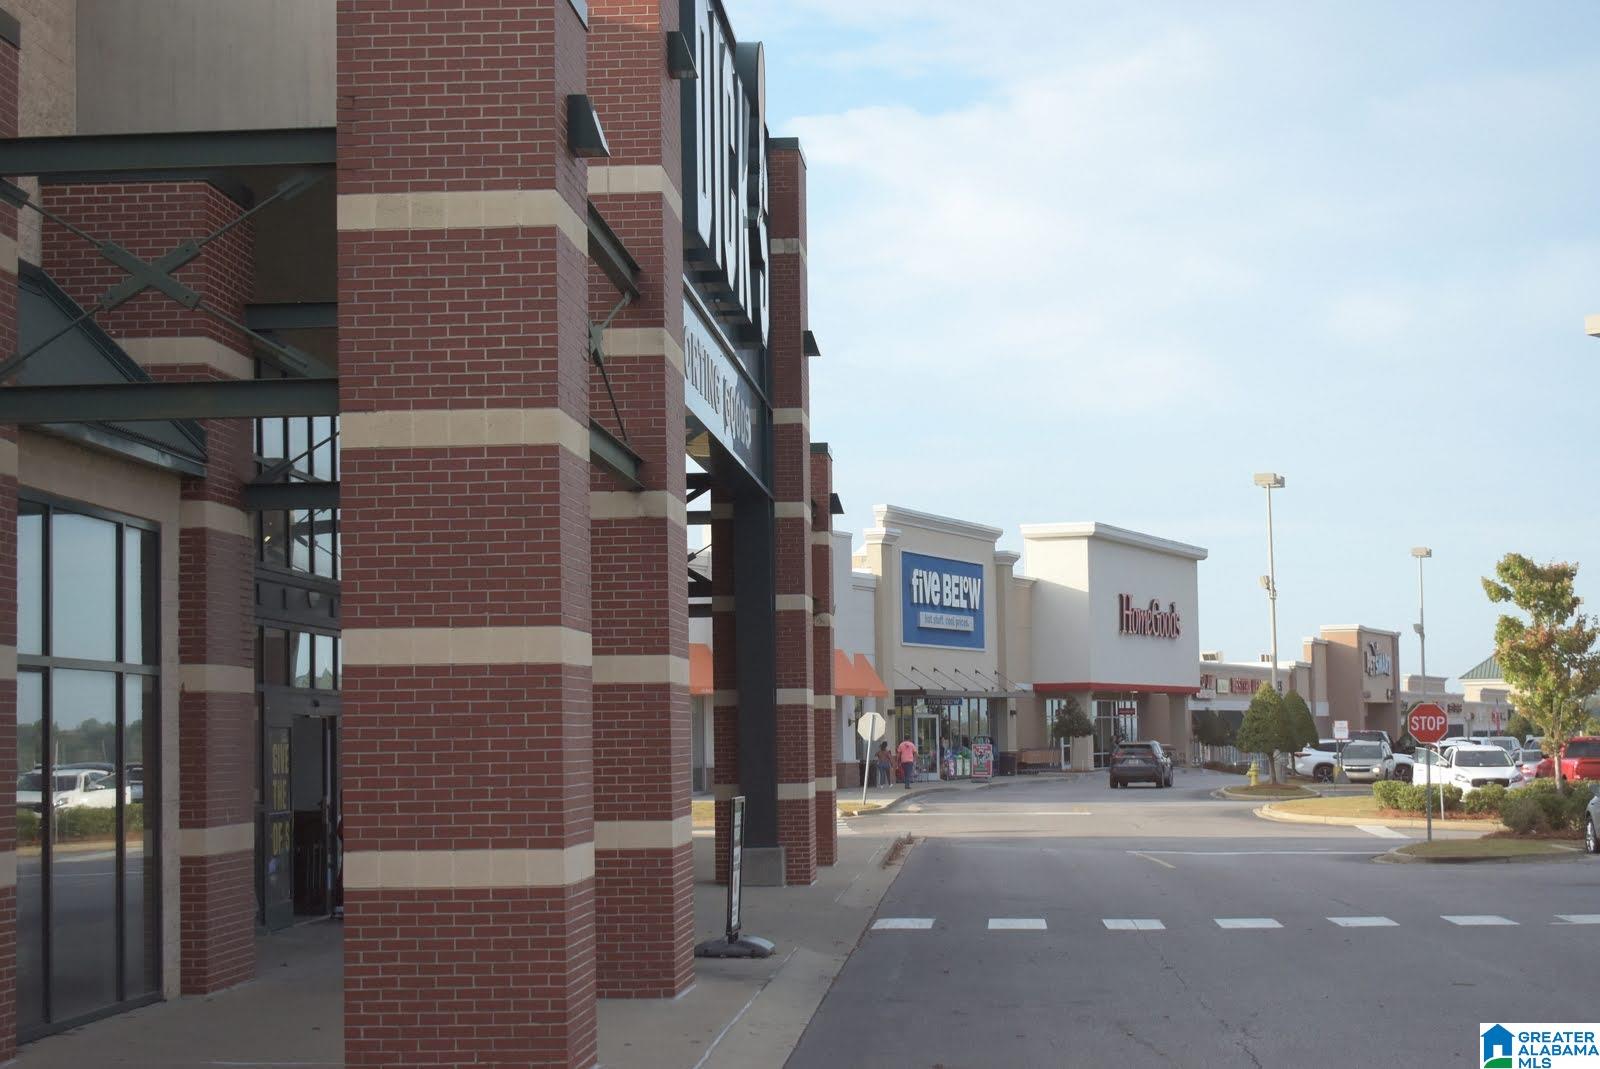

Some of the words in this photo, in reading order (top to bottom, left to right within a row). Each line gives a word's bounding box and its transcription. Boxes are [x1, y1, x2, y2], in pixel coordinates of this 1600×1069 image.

[684, 324, 720, 415] ORTING
[1118, 592, 1182, 639] HomeGoods
[1410, 715, 1446, 731] STOP
